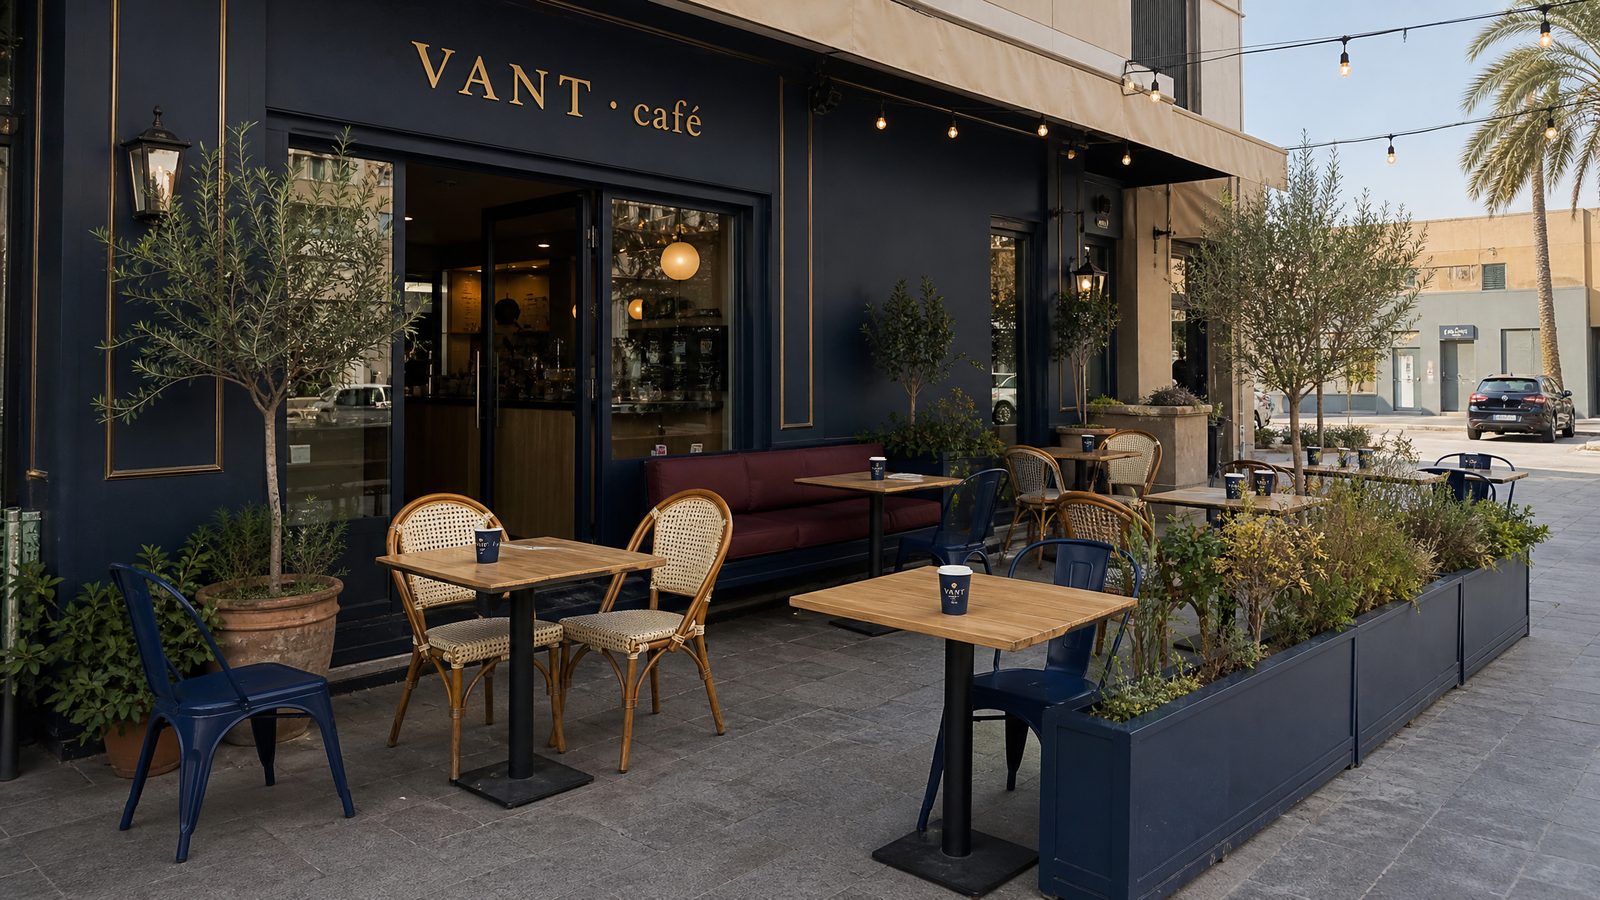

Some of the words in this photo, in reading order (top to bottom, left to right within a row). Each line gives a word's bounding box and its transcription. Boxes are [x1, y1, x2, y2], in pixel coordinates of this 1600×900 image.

[411, 40, 591, 118] VANT
[633, 99, 702, 137] café
[943, 587, 965, 595] VANT
